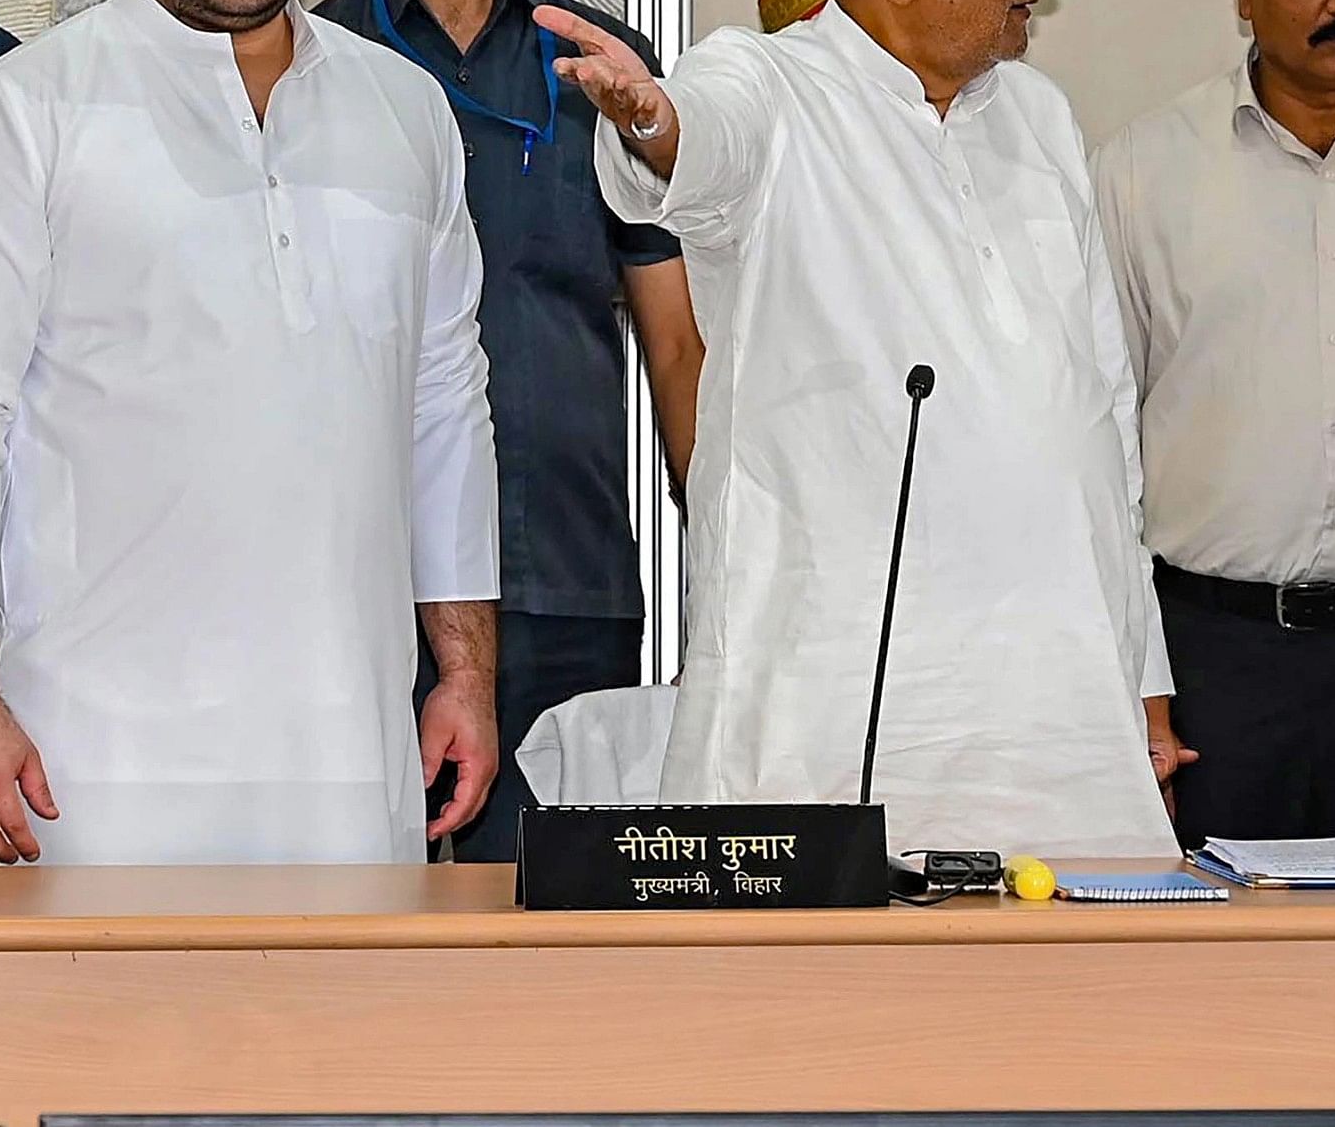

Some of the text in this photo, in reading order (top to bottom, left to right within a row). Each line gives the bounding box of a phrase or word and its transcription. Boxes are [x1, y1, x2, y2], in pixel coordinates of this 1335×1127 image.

[614, 825, 797, 871] नीतीश कुमार
[631, 871, 720, 902] मुख्यमंत्री,
